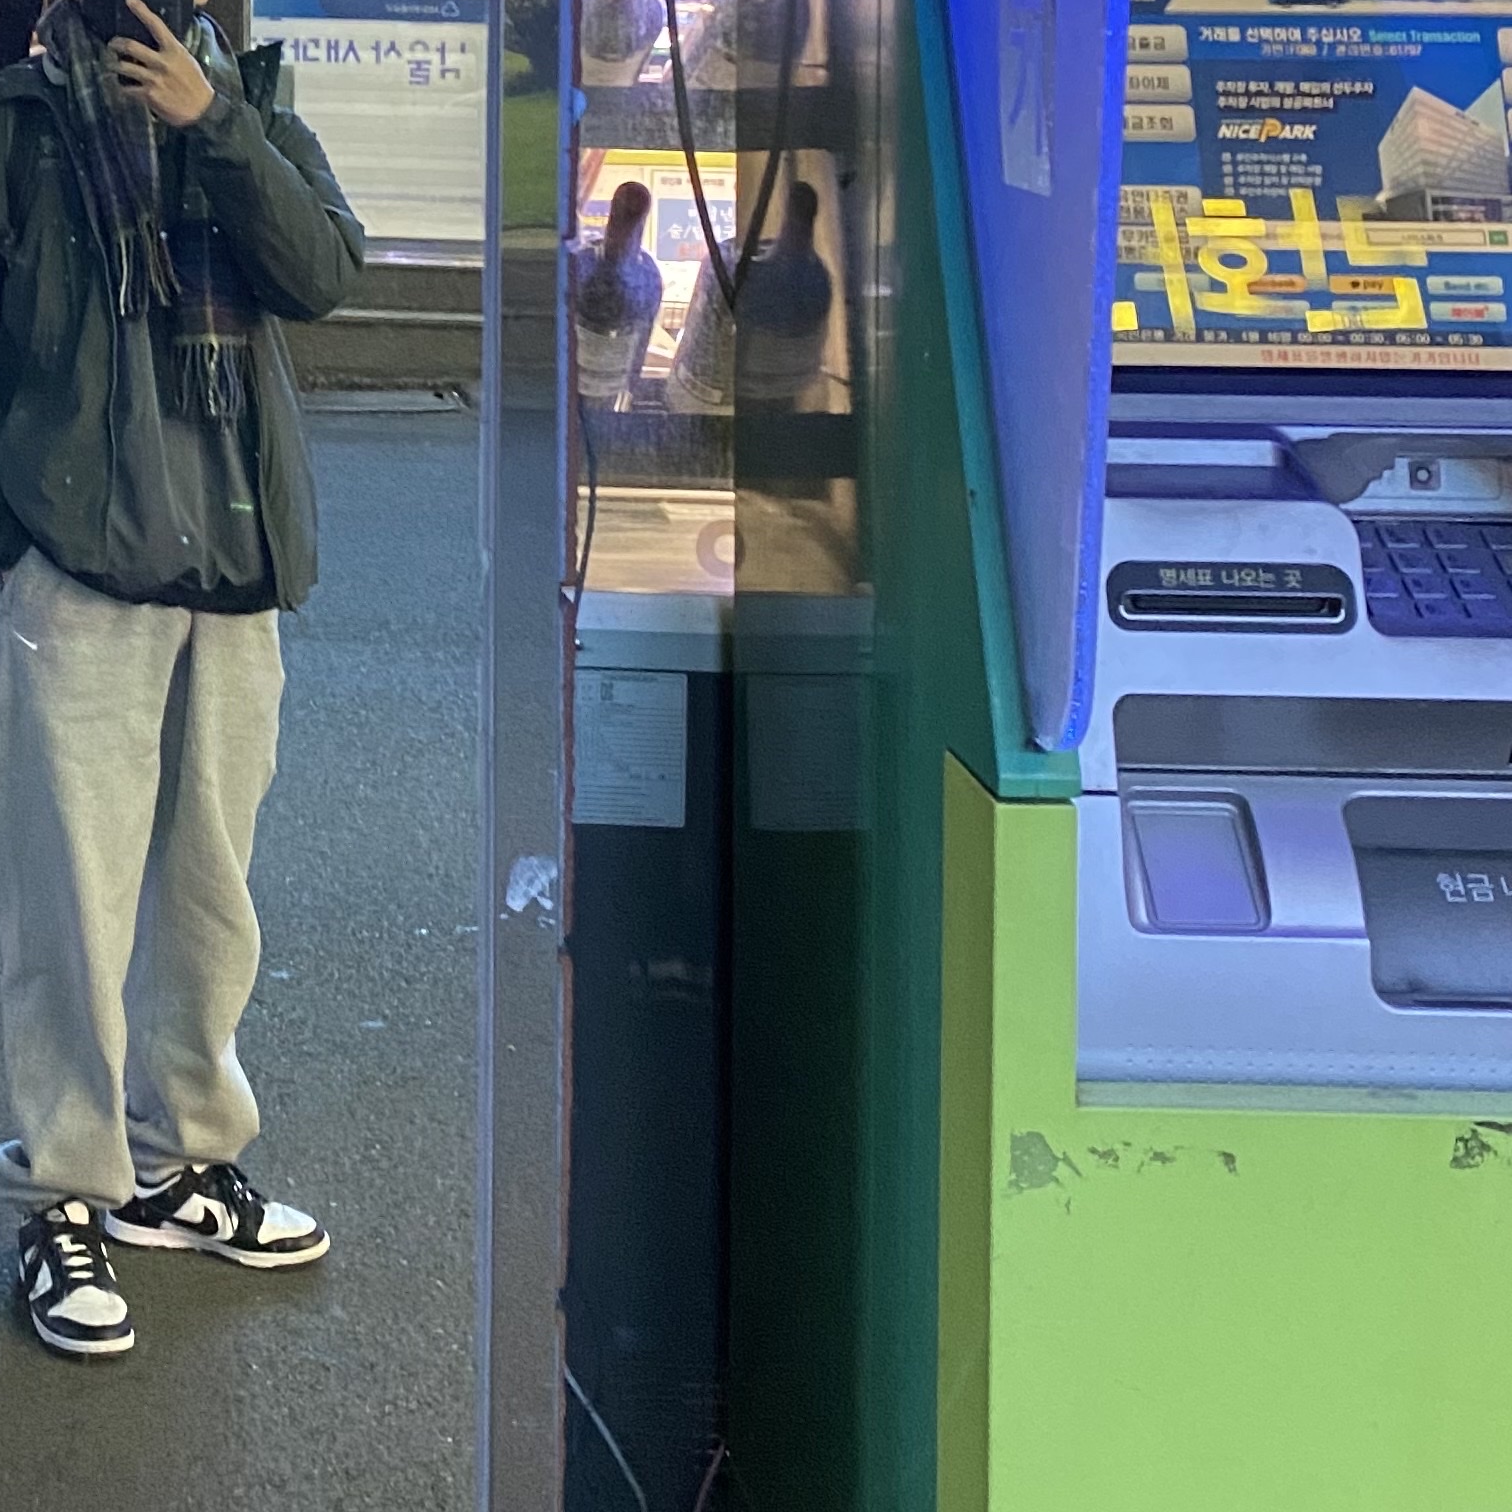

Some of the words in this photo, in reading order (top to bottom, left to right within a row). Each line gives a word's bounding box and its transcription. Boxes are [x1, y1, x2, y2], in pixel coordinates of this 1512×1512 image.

[1245, 26, 1303, 43] 선택하여
[1306, 27, 1363, 43] 주십시오
[1410, 29, 1481, 43] Transaction
[1217, 117, 1318, 143] NICEPARK
[1158, 567, 1216, 587] 명세표
[1220, 567, 1276, 588] 나오는
[1283, 568, 1303, 589] 곳
[1436, 871, 1495, 903] 현금
